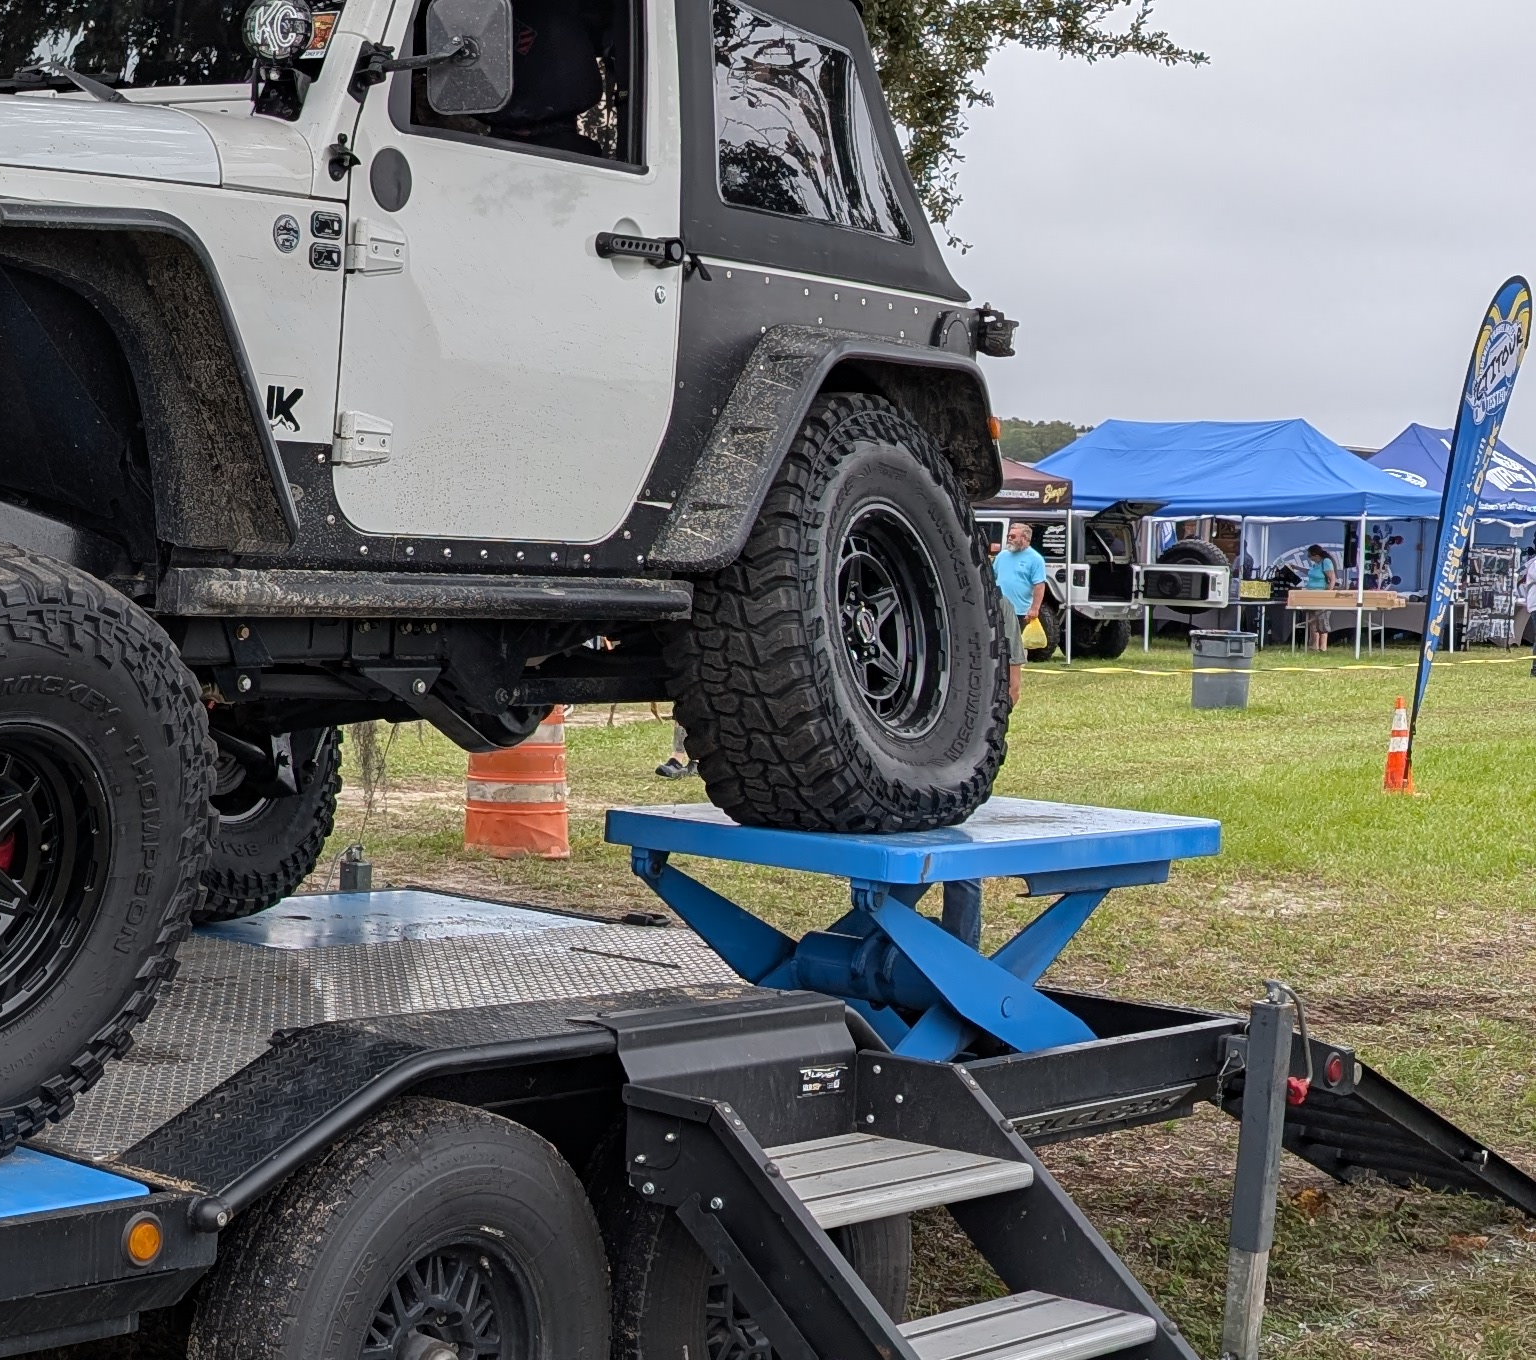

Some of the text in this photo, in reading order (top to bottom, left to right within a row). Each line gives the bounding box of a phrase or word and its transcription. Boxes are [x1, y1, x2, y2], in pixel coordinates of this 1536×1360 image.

[255, 0, 298, 53] KC
[1, 674, 162, 955] MICKEY THOMPSON
